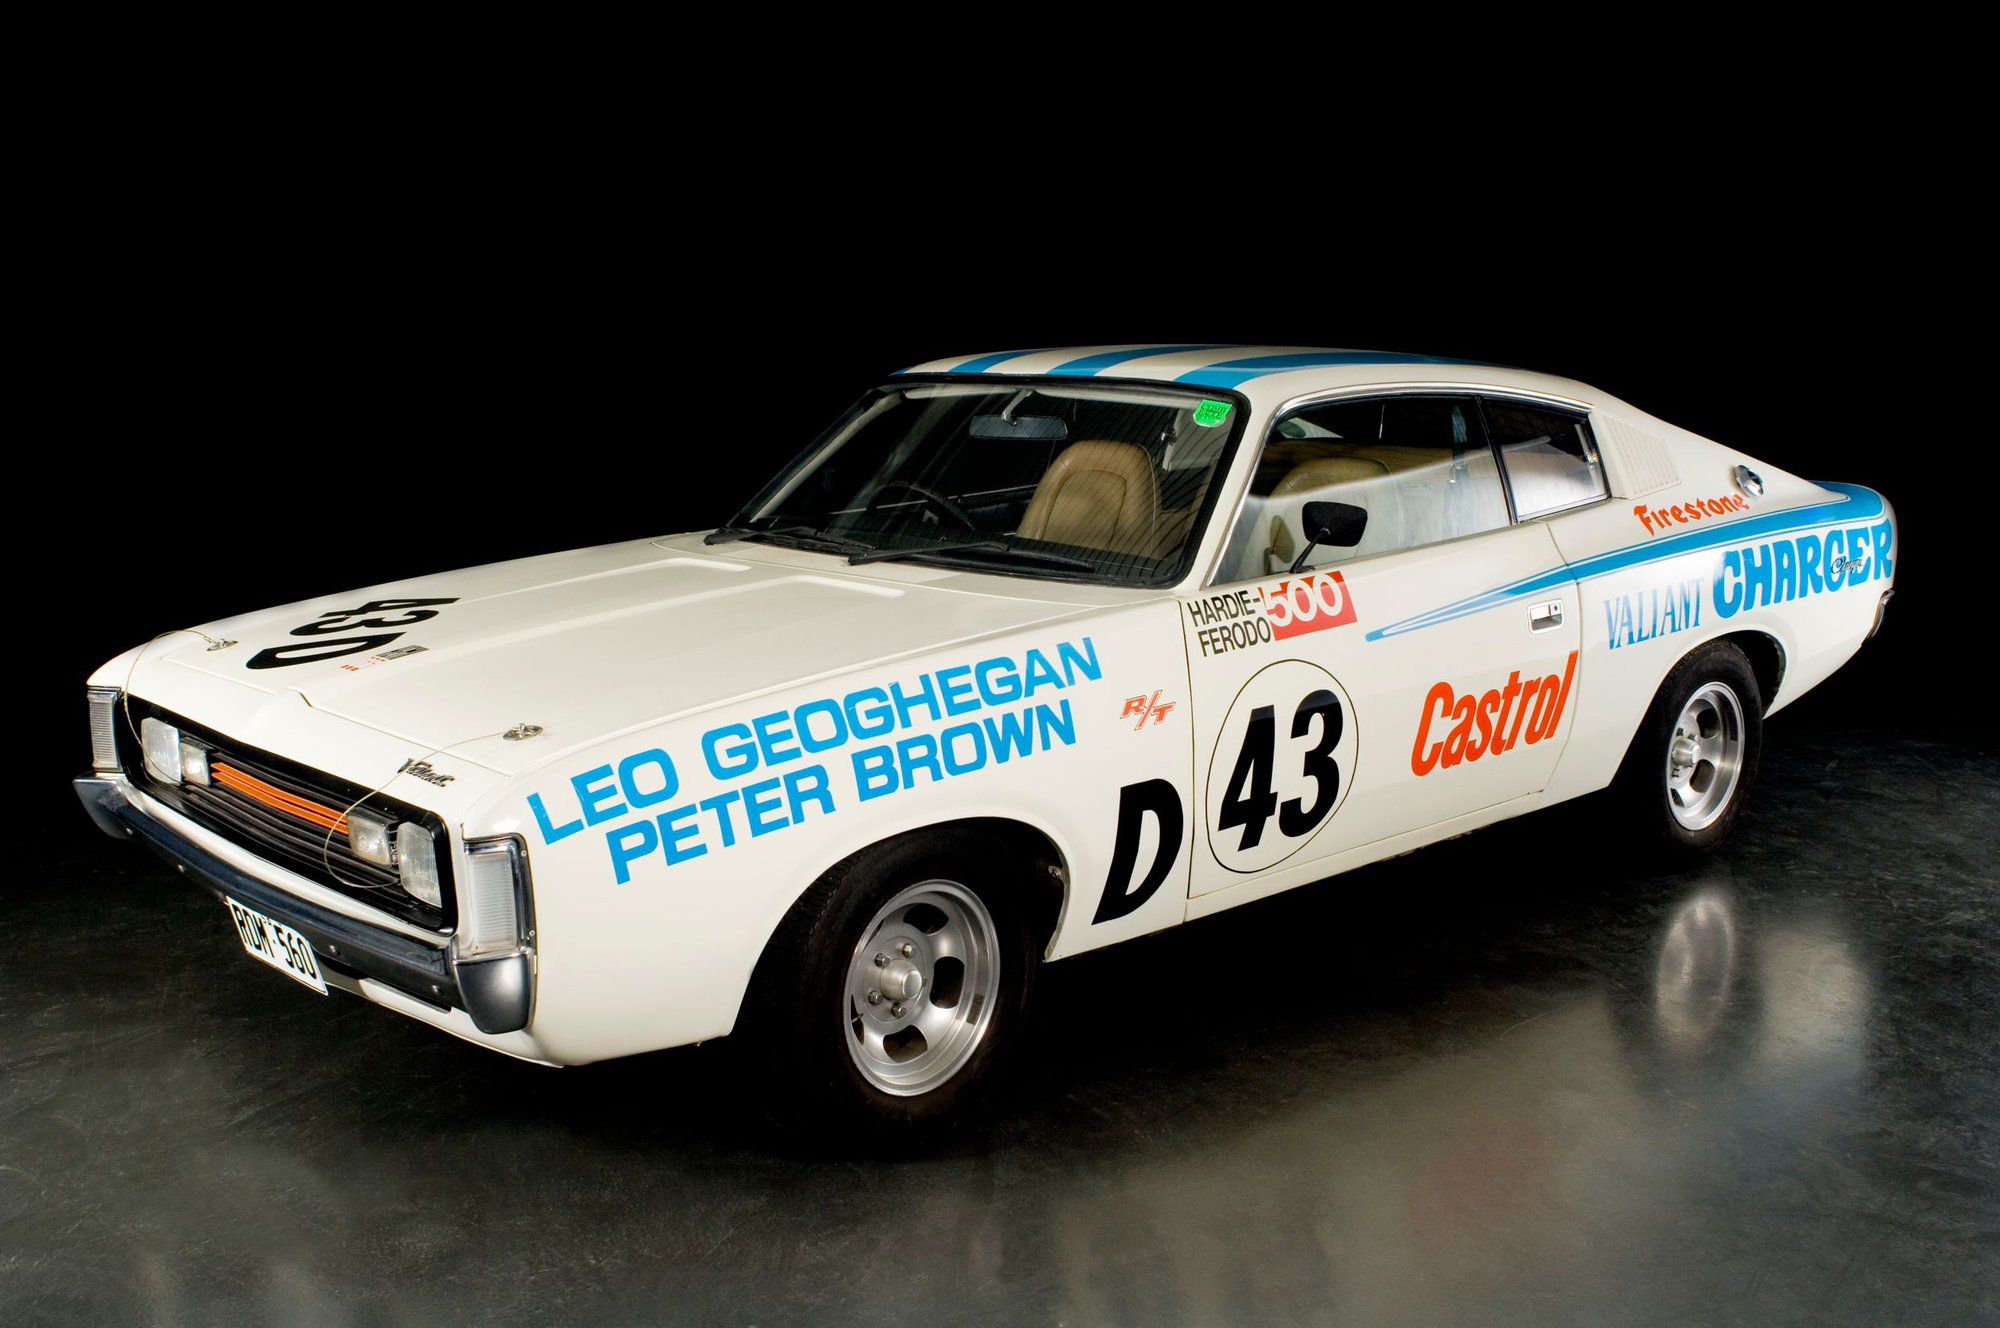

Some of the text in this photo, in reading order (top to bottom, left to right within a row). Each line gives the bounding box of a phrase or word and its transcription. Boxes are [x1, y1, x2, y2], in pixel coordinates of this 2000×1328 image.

[1632, 494, 1750, 537] Firestone
[289, 597, 461, 637] 43
[1187, 571, 1344, 628] HARDIE- 500
[1603, 518, 1893, 650] VALIANT CHARGER
[245, 631, 407, 670] D
[1197, 616, 1272, 657] FERODO
[526, 636, 1103, 846] LEO GEOGHEGAN
[1119, 689, 1177, 731] R/T
[1410, 649, 1580, 778] Castrol
[605, 698, 1077, 886] PETER BROWN
[1217, 689, 1344, 852] 43
[1091, 778, 1184, 926] D
